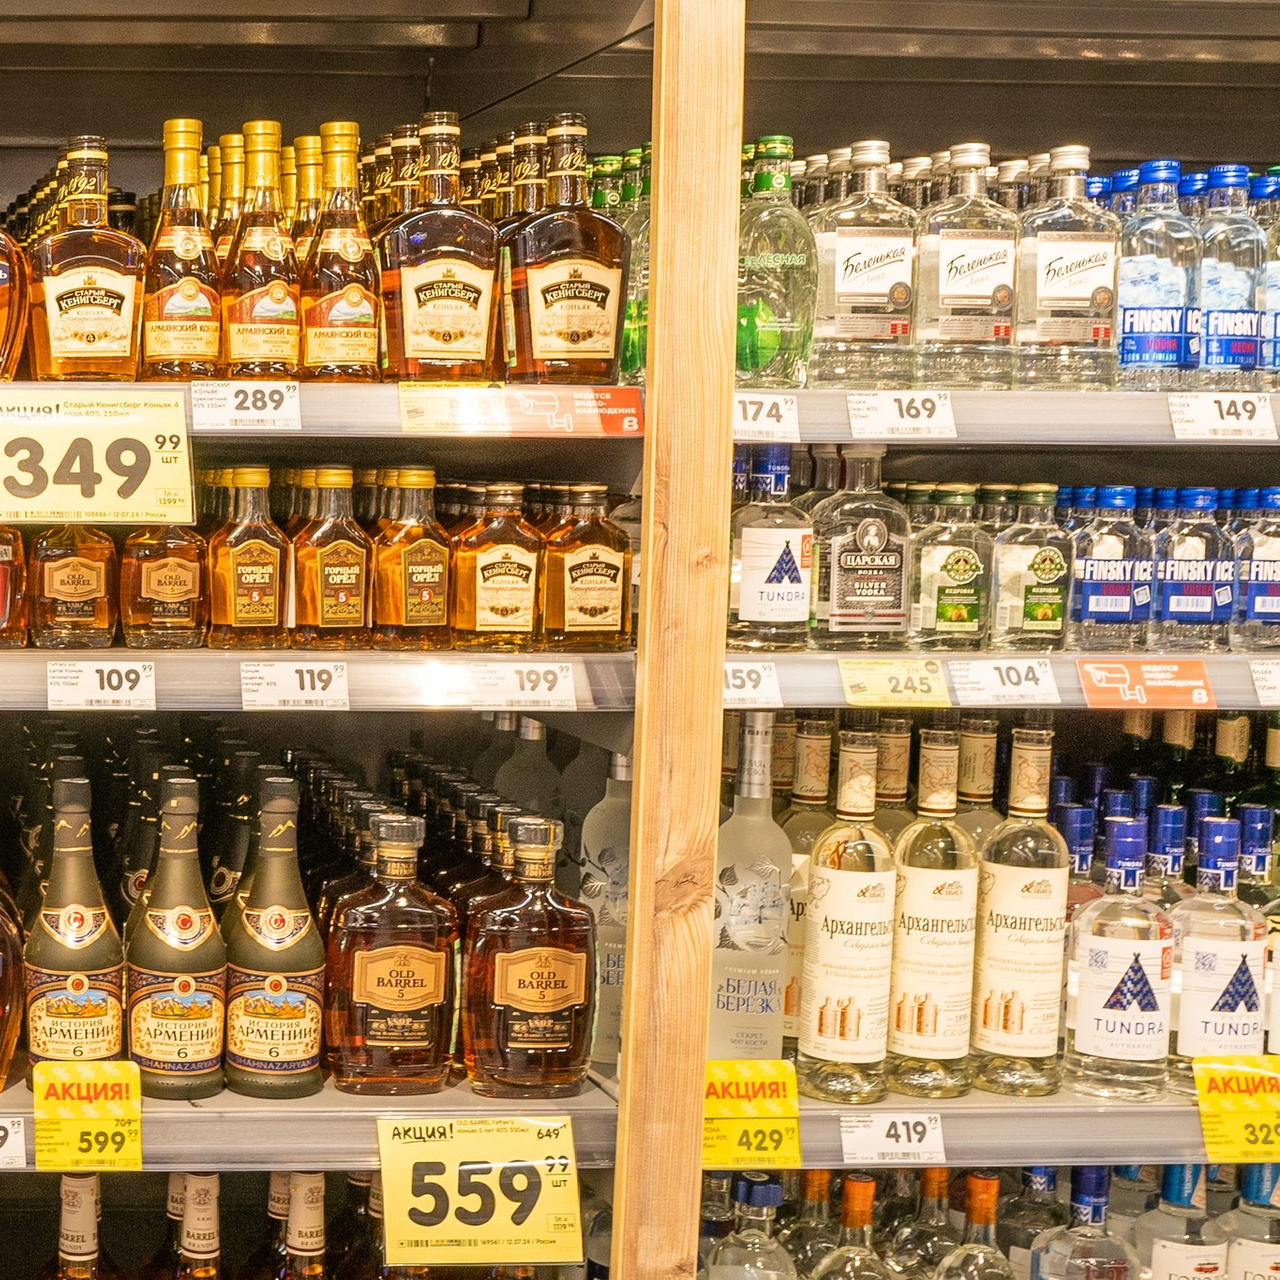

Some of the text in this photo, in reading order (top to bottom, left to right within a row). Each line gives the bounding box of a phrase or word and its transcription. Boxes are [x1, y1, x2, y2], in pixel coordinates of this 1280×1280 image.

[150, 323, 197, 333] АРМЯНСКИЙ
[1125, 312, 1182, 333] FINSKY
[1209, 312, 1258, 337] FINSKY
[63, 401, 94, 411] Старый
[97, 401, 140, 411] Кенигсберг
[234, 385, 296, 410] 289 99
[737, 401, 781, 423] 174
[894, 397, 937, 418] 169
[1213, 399, 1256, 420] 149
[3, 435, 181, 498] 349 99
[144, 511, 167, 519] Россия
[846, 555, 895, 566] ЦАРСКАЯ
[237, 564, 273, 575] ГОРНЫЙ
[1085, 560, 1133, 581] FINSKY
[242, 574, 269, 583] ОРЁЛ
[758, 589, 805, 602] TUNDRA
[95, 669, 140, 690] 109
[295, 669, 333, 690] 119
[334, 664, 345, 672] 99
[515, 669, 558, 690] 199
[994, 665, 1040, 686] 104
[888, 676, 932, 693] 245
[388, 969, 414, 979] OLD
[376, 976, 426, 990] BARREL
[725, 979, 777, 995] БЕЛАЯ
[52, 1019, 102, 1028] ИСТОРИЯ
[156, 1020, 206, 1030] ИСТОРИЯ
[1094, 1018, 1163, 1034] TUNDRA
[41, 1025, 115, 1040] АРМЕНИИ
[145, 1026, 220, 1040] АРМЕНИИ
[235, 1058, 312, 1071] SHAHNAZARYAN
[44, 1082, 131, 1103] АКЦИЯ!
[705, 1082, 788, 1100] АКЦИЯ!
[392, 1124, 453, 1142] АКЦИЯ!
[537, 1128, 560, 1141] 649
[737, 1130, 783, 1151] 429
[885, 1122, 927, 1142] 419
[77, 1132, 125, 1152] 599
[409, 1156, 569, 1225] 559 99
[551, 1179, 568, 1187] шт
